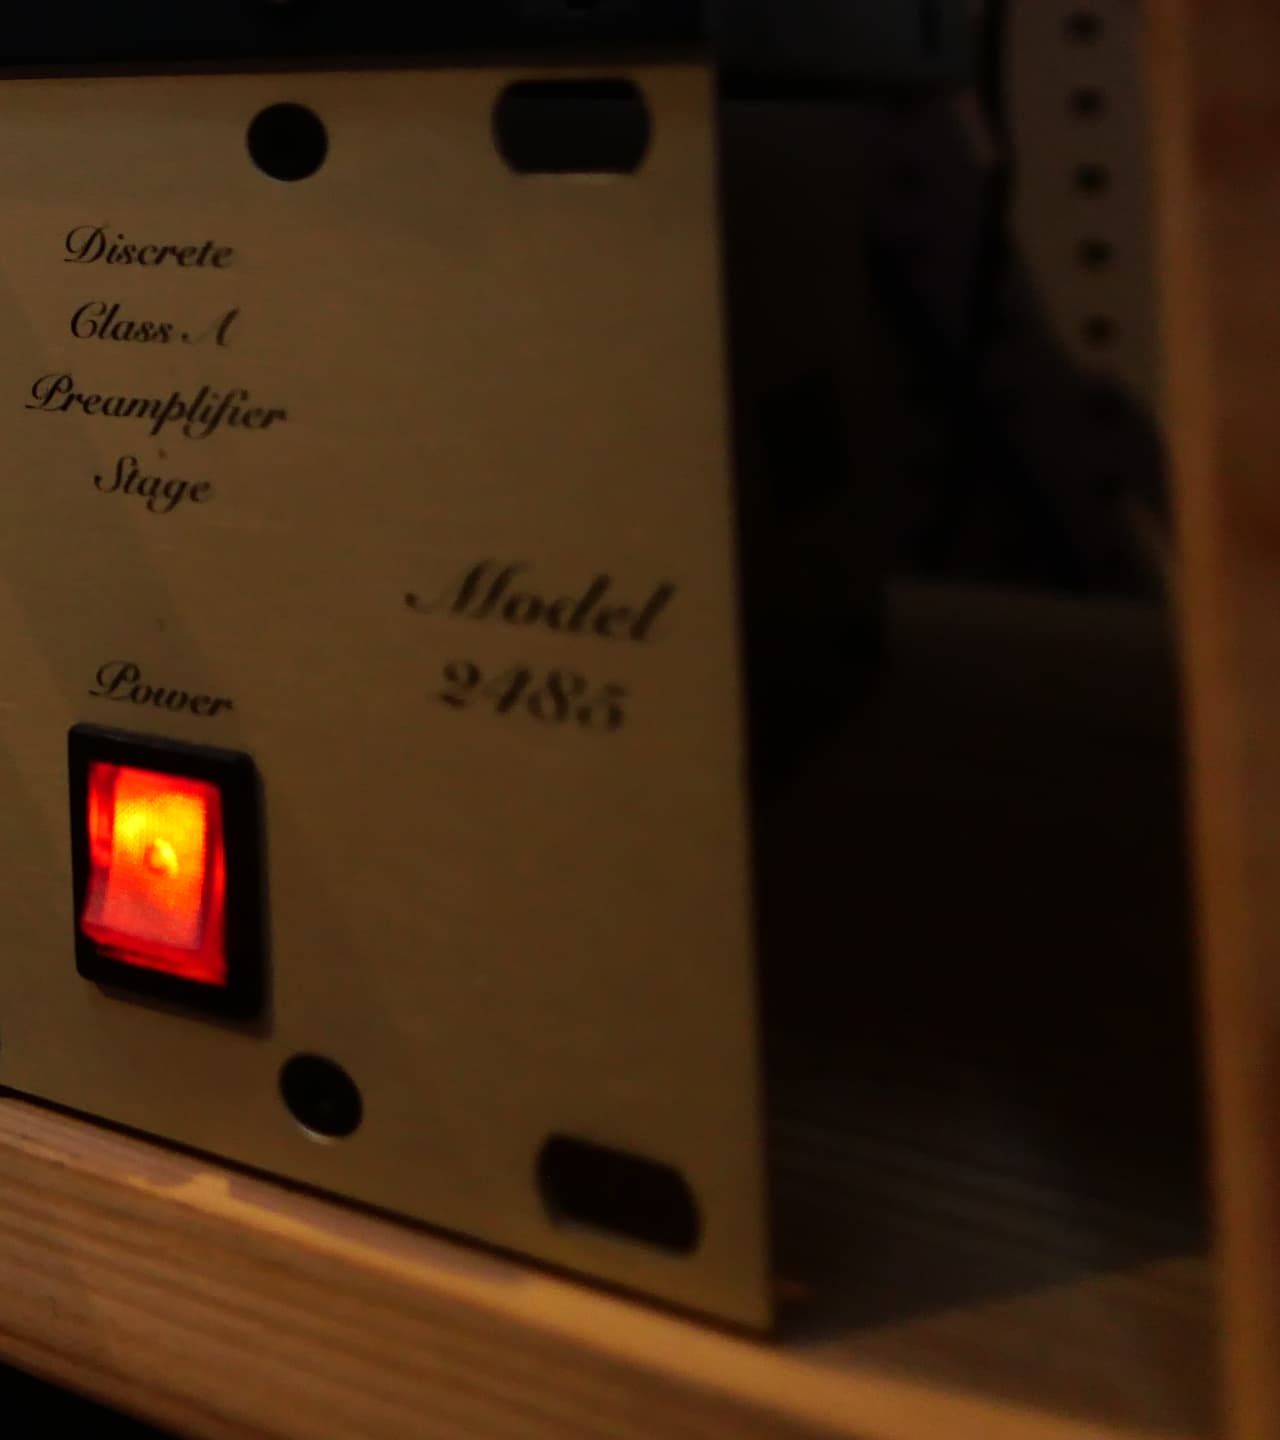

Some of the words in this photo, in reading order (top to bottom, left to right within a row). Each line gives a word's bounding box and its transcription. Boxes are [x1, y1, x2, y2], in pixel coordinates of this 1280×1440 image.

[64, 225, 234, 268] Discrete
[70, 300, 174, 344] Class
[181, 307, 241, 346] A
[25, 374, 288, 440] Preamplifier
[94, 455, 211, 514] Stage
[404, 558, 677, 644] Model
[89, 660, 234, 718] Power
[438, 659, 631, 734] 2485
